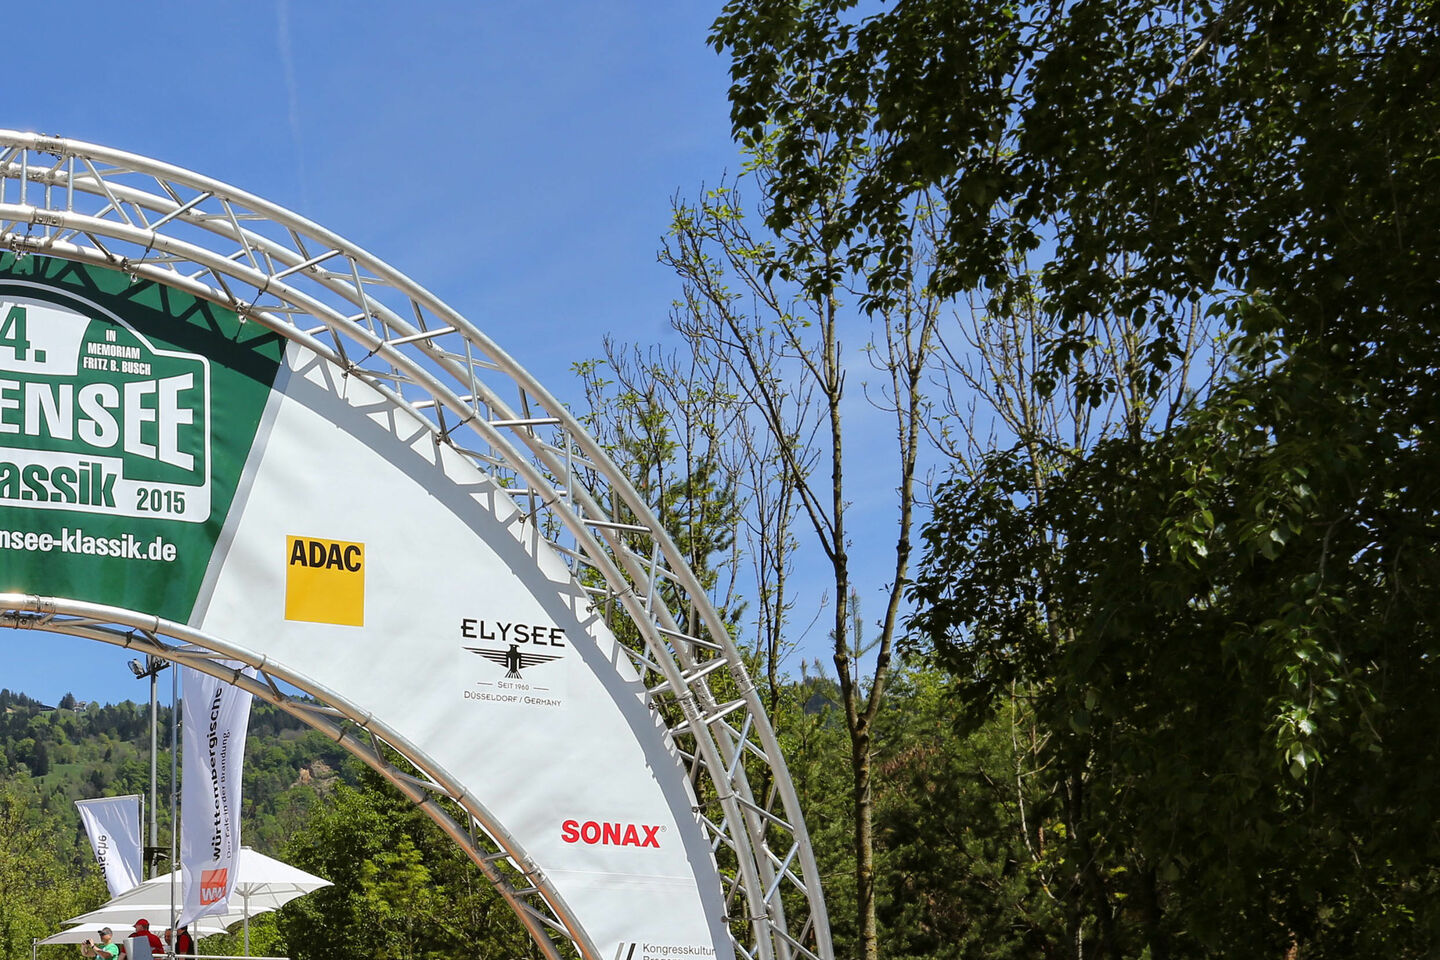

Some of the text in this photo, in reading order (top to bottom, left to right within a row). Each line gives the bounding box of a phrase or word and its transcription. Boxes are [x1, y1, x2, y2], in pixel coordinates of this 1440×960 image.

[105, 329, 117, 341] IN
[87, 341, 141, 360] MEMORIAM
[83, 356, 152, 376] FRITZ B. BUSCH
[136, 487, 186, 514] 2015
[290, 539, 362, 573] ADAC
[460, 618, 566, 648] ELYSEE
[524, 696, 562, 708] GERMANY
[207, 687, 223, 861] württembergische
[561, 819, 661, 848] SONAX
[643, 943, 716, 958] Kongresskultur
